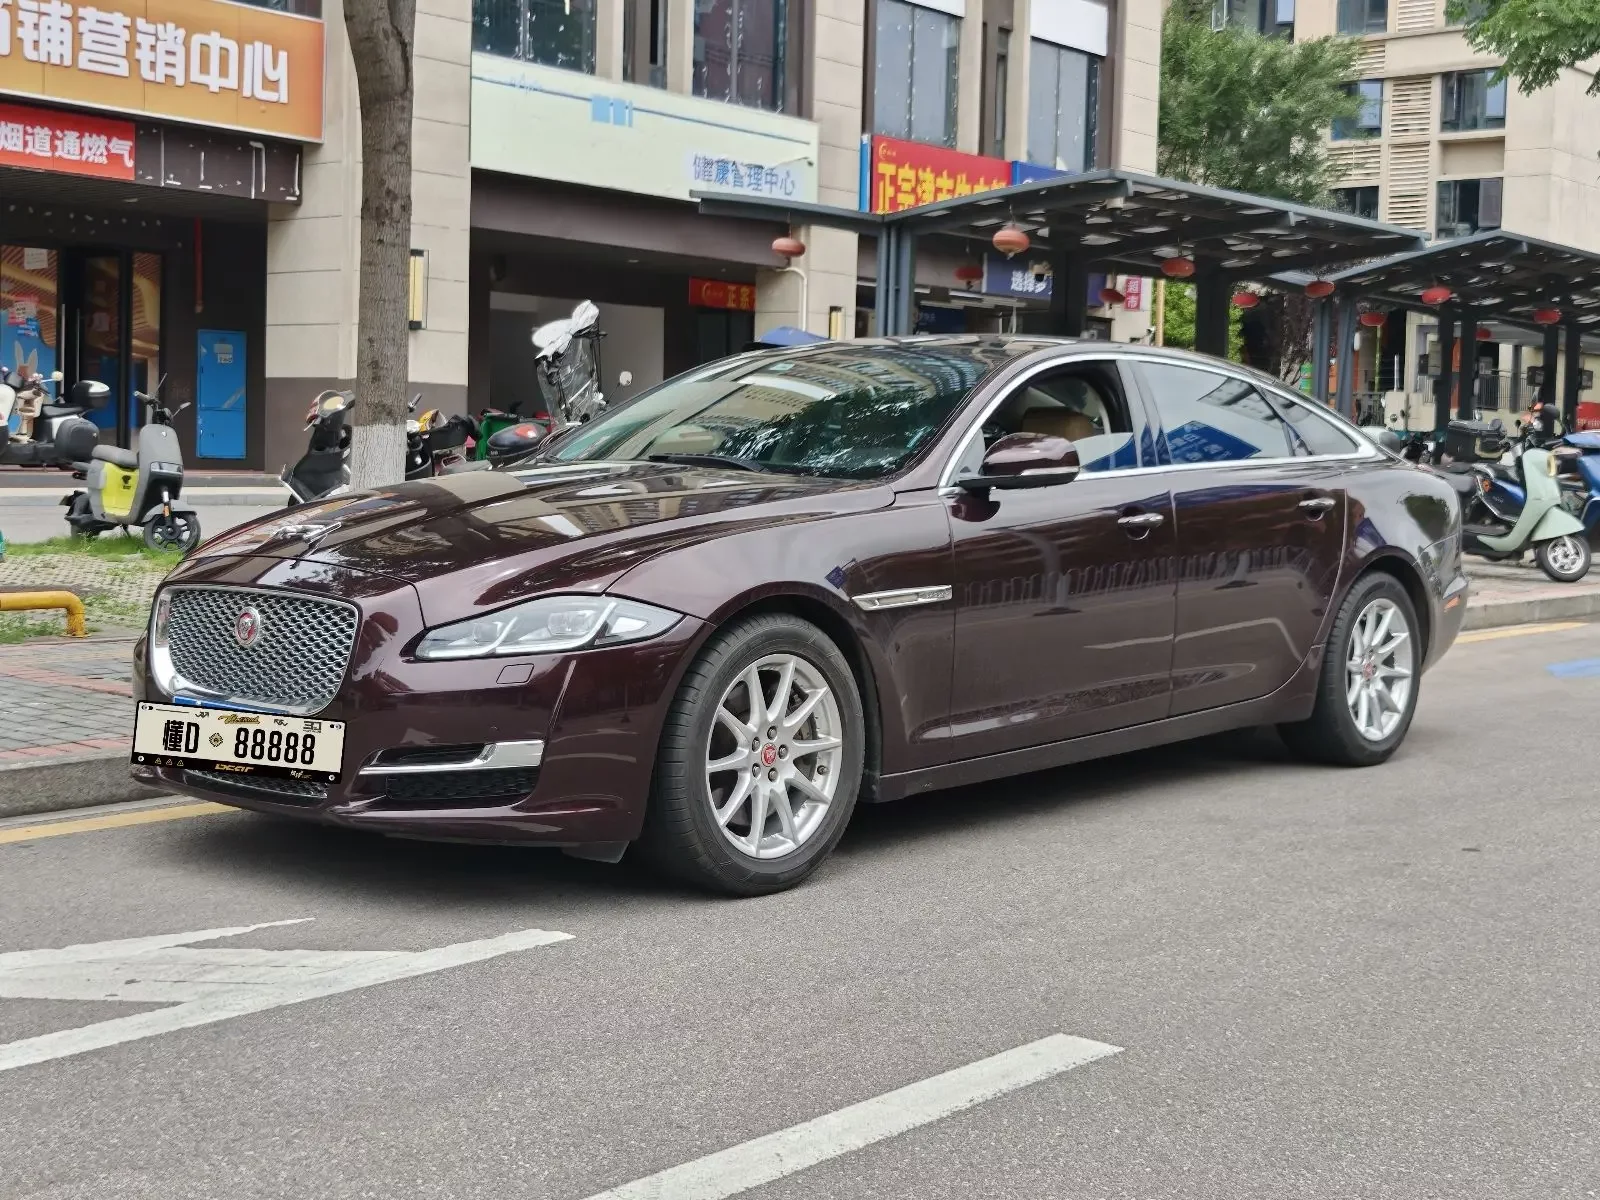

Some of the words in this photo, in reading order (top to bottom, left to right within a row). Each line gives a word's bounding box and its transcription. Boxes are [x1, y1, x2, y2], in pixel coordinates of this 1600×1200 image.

[0, 0, 288, 103] 铺营销中心
[234, 727, 315, 765] 88888
